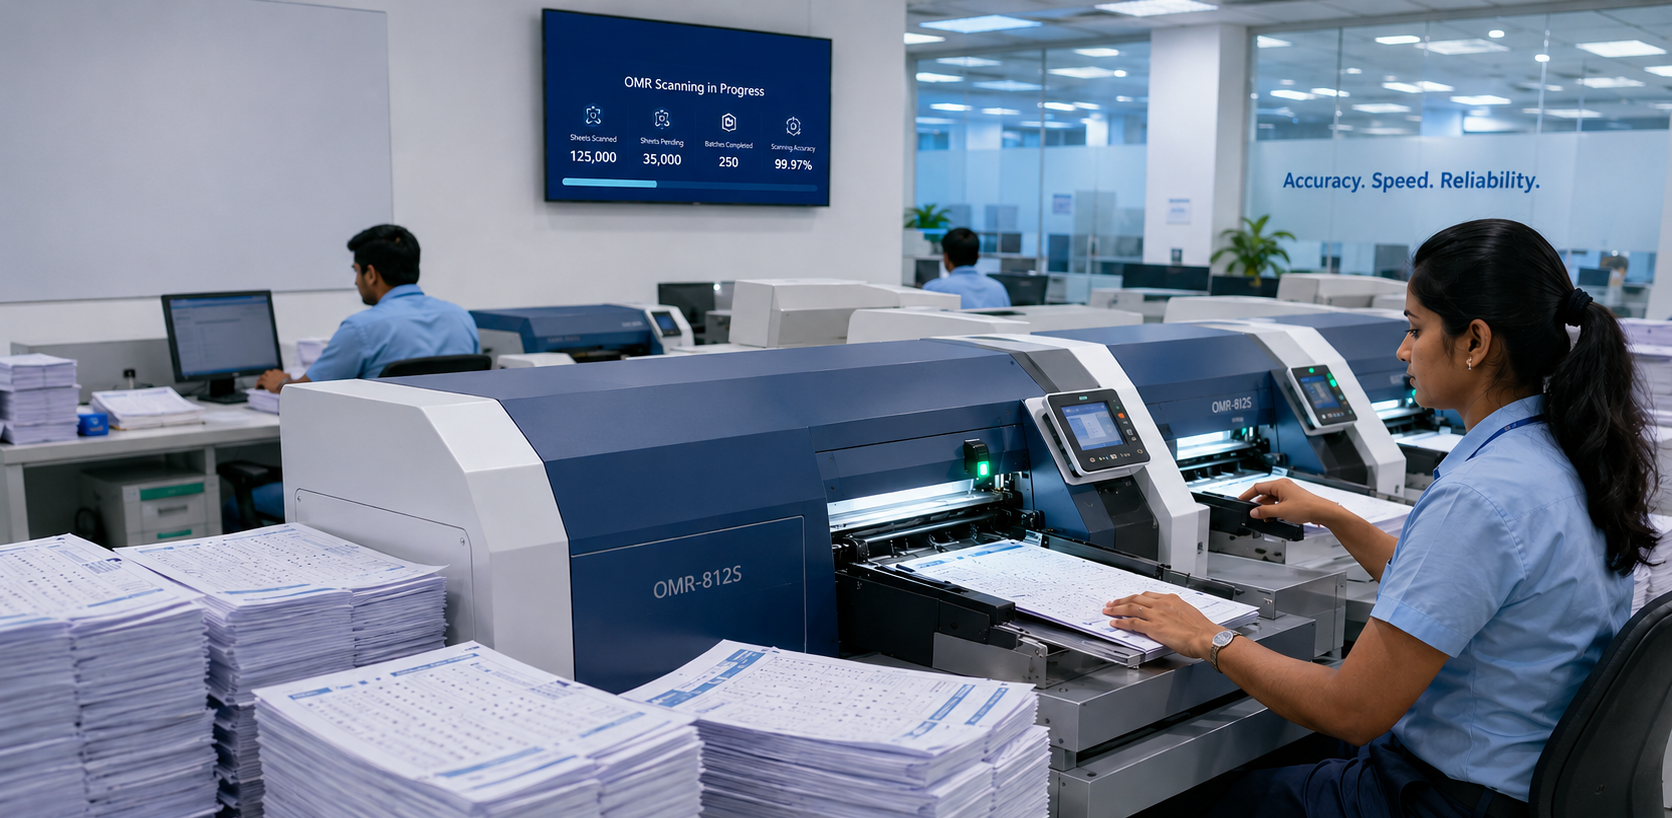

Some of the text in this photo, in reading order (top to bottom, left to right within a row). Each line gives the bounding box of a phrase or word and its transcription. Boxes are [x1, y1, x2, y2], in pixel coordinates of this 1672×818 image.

[624, 76, 765, 98] OMR Scanning in Progress
[570, 133, 618, 143] Sheets Scanned
[570, 150, 617, 164] 125,000
[643, 153, 682, 167] 35,000
[719, 156, 739, 168] 250
[774, 158, 813, 170] 99.97%
[1282, 171, 1540, 193] Accuracy. Speed. Reliability.
[653, 564, 742, 599] OMR-812S
